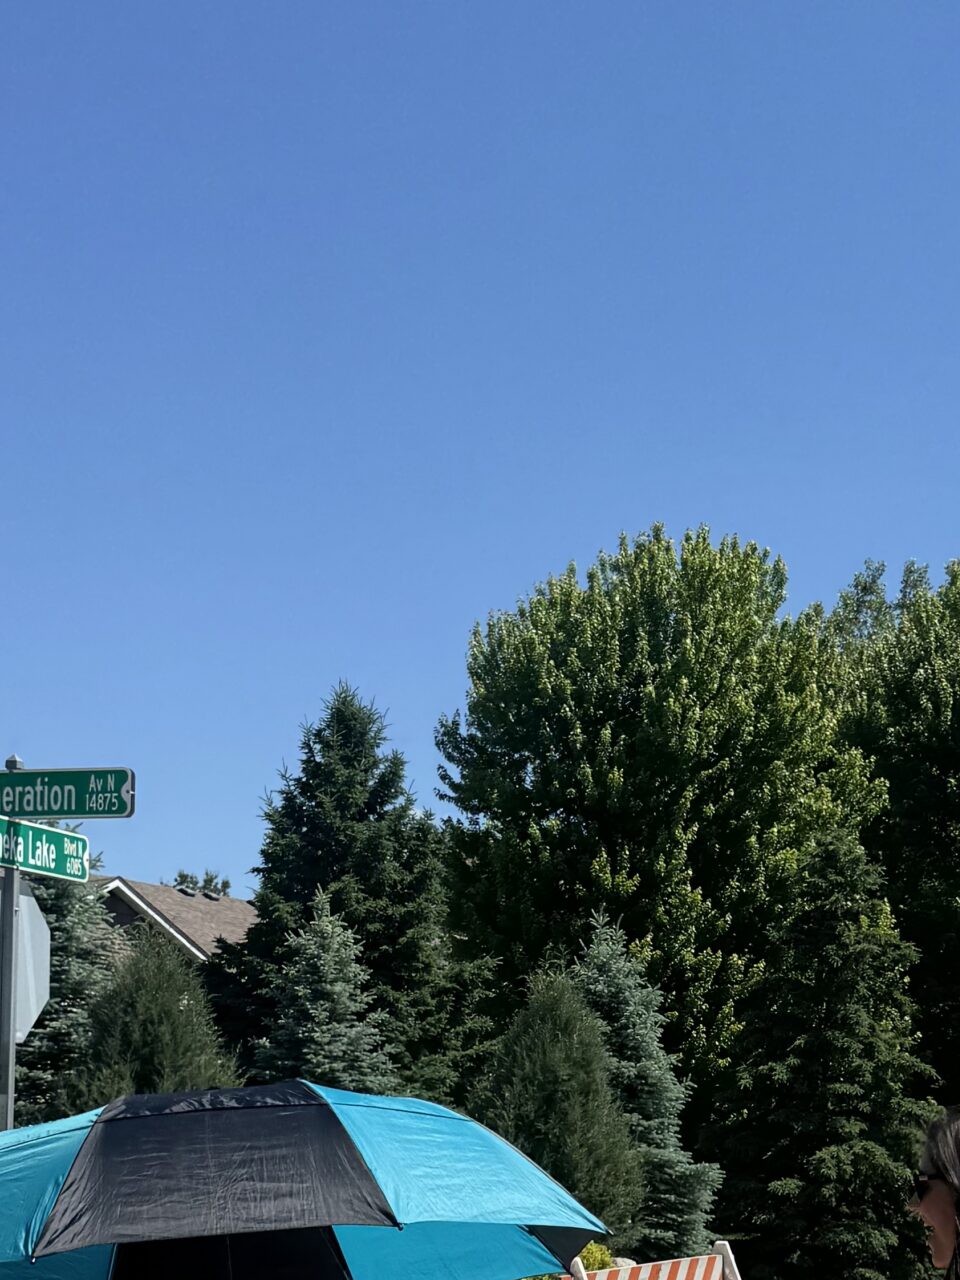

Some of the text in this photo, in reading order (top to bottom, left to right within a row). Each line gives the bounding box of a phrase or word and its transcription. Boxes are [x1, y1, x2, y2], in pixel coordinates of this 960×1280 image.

[89, 773, 115, 792] Av N
[3, 777, 76, 812] eration
[85, 793, 119, 811] 14875
[28, 830, 57, 870] Lake
[64, 837, 83, 859] Blvd N
